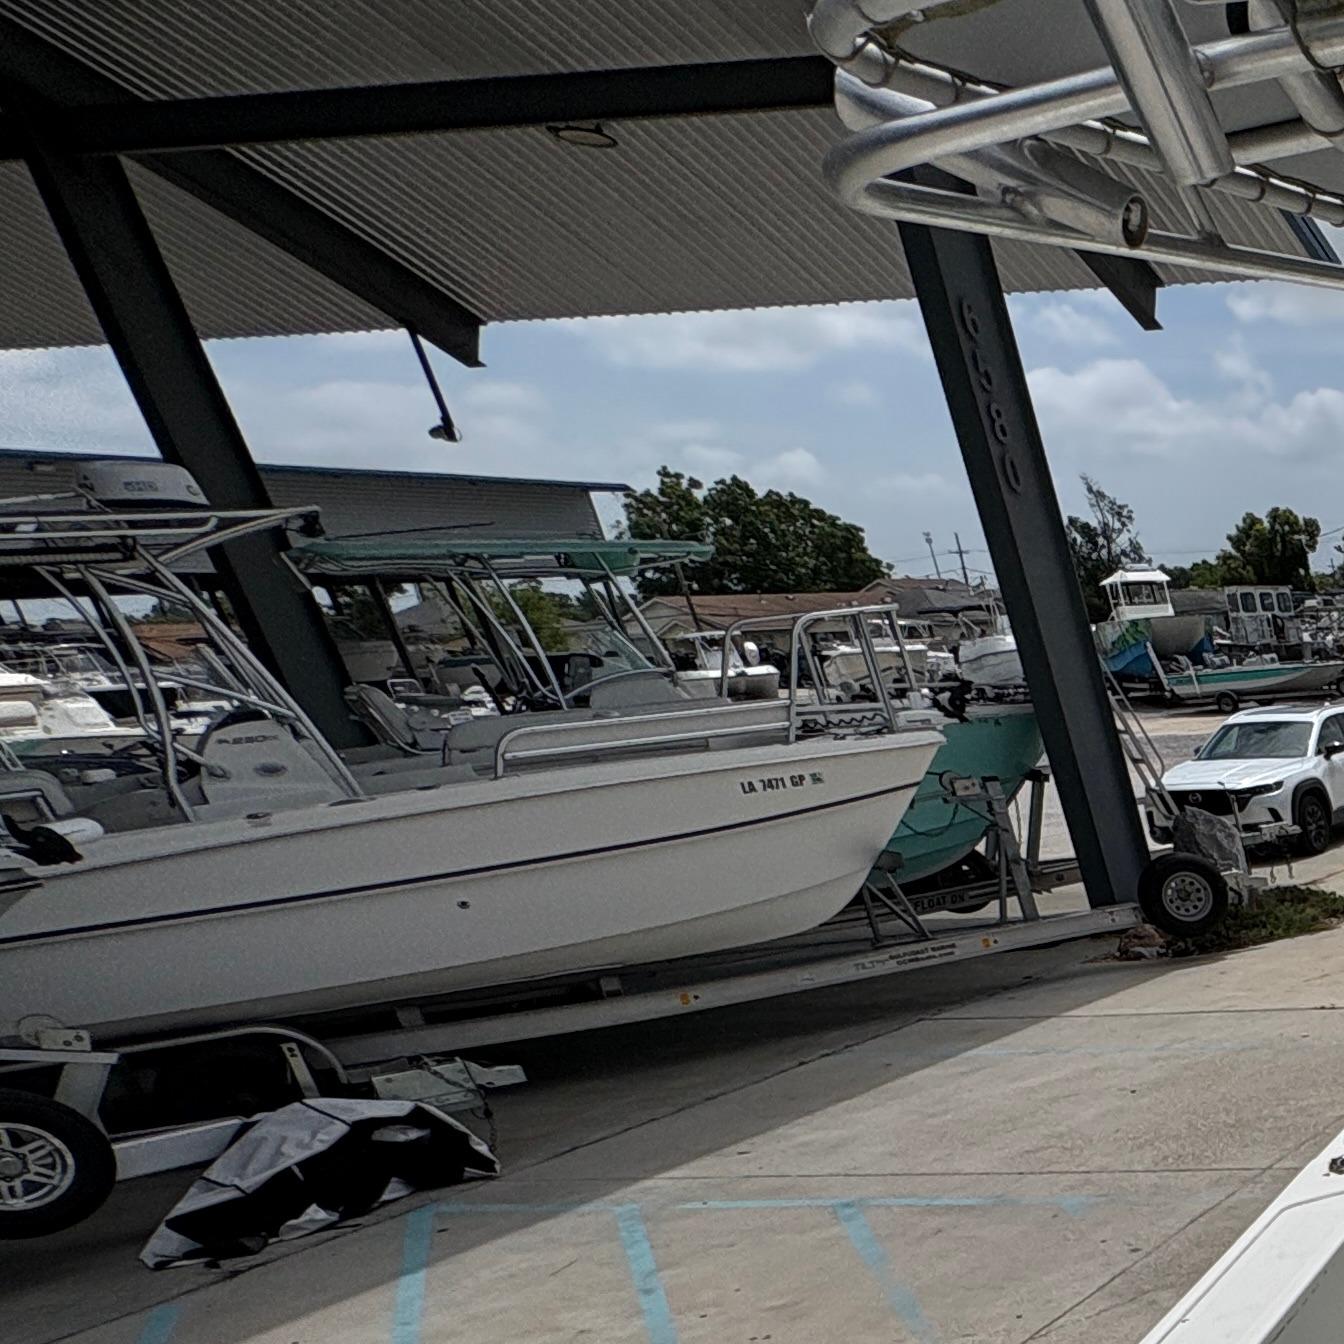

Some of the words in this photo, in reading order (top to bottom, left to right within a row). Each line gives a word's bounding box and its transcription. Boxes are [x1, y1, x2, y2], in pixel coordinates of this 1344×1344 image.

[740, 781, 758, 795] LA
[759, 777, 787, 792] 7471
[790, 774, 806, 788] GP
[914, 895, 948, 912] FLOAT
[952, 892, 966, 903] ON
